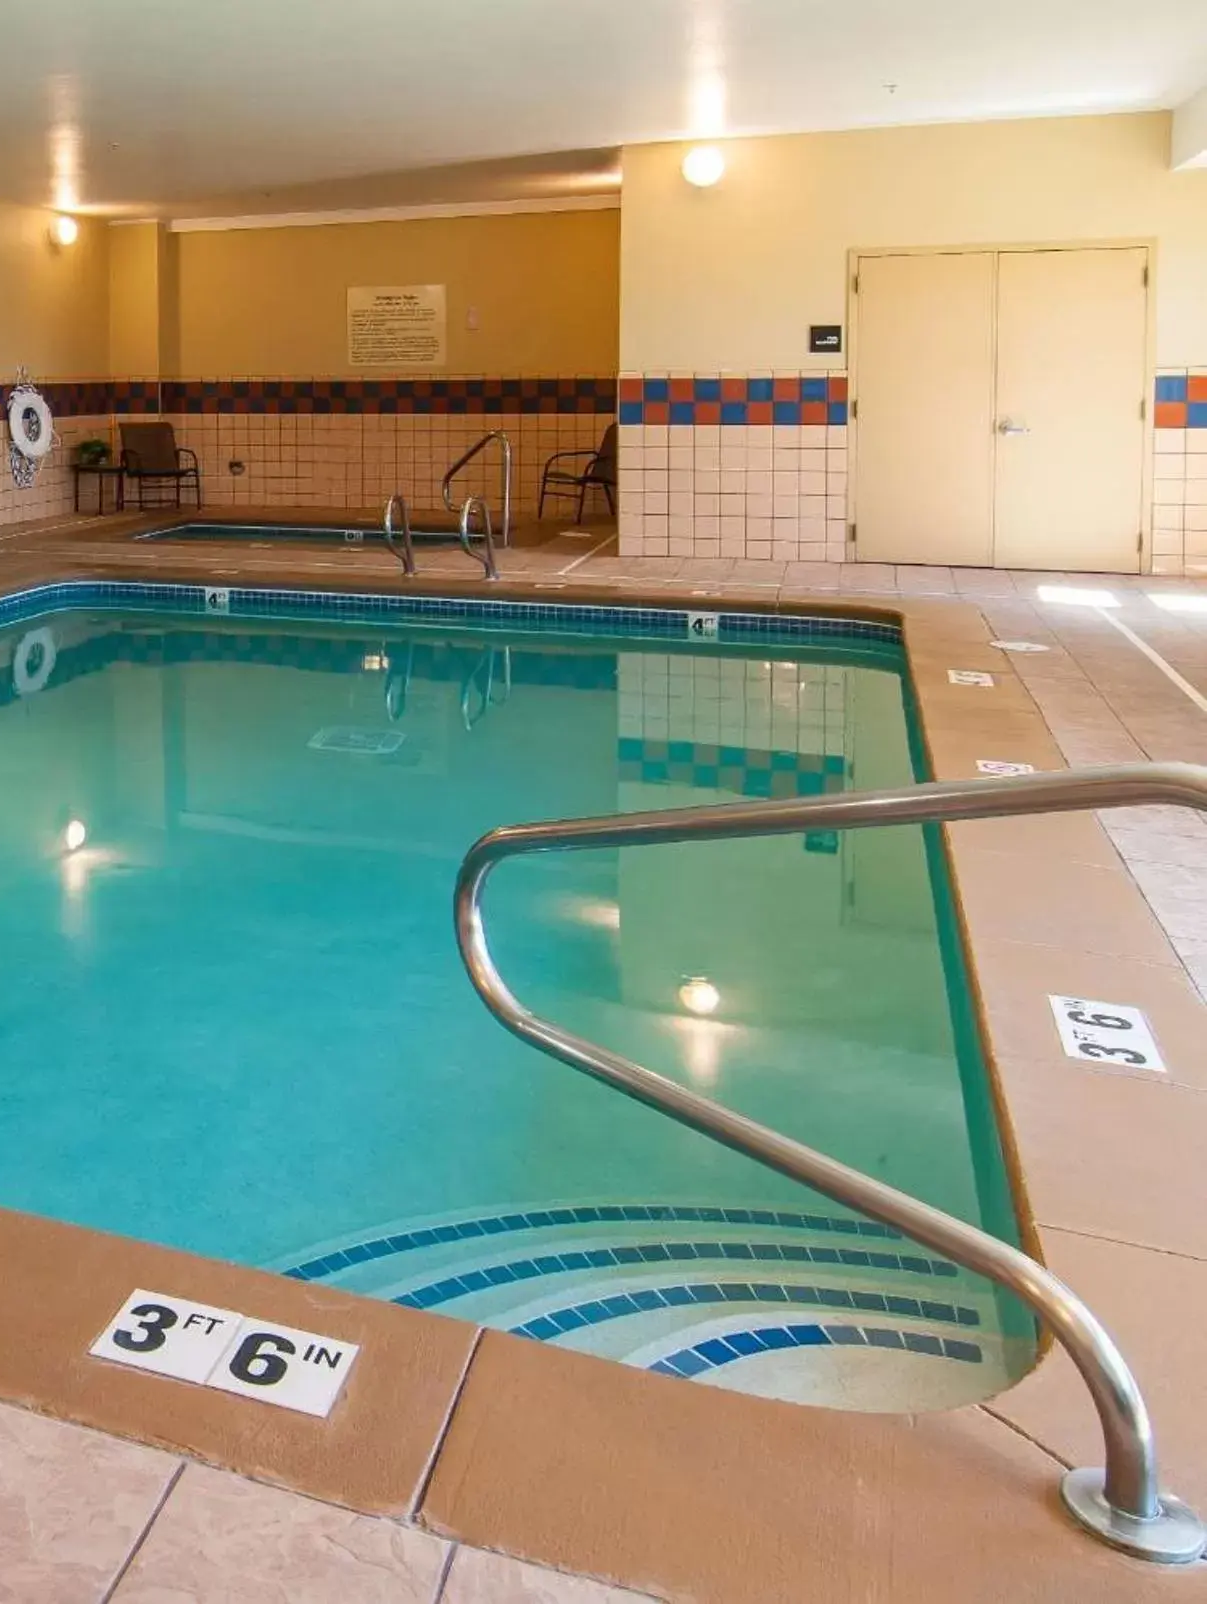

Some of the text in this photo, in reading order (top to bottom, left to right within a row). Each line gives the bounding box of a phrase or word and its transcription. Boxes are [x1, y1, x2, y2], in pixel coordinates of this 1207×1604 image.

[692, 617, 703, 637] 4
[1067, 1010, 1133, 1030] 6
[1078, 1042, 1147, 1065] 3
[112, 1303, 343, 1386] 3 FT 6 IN
